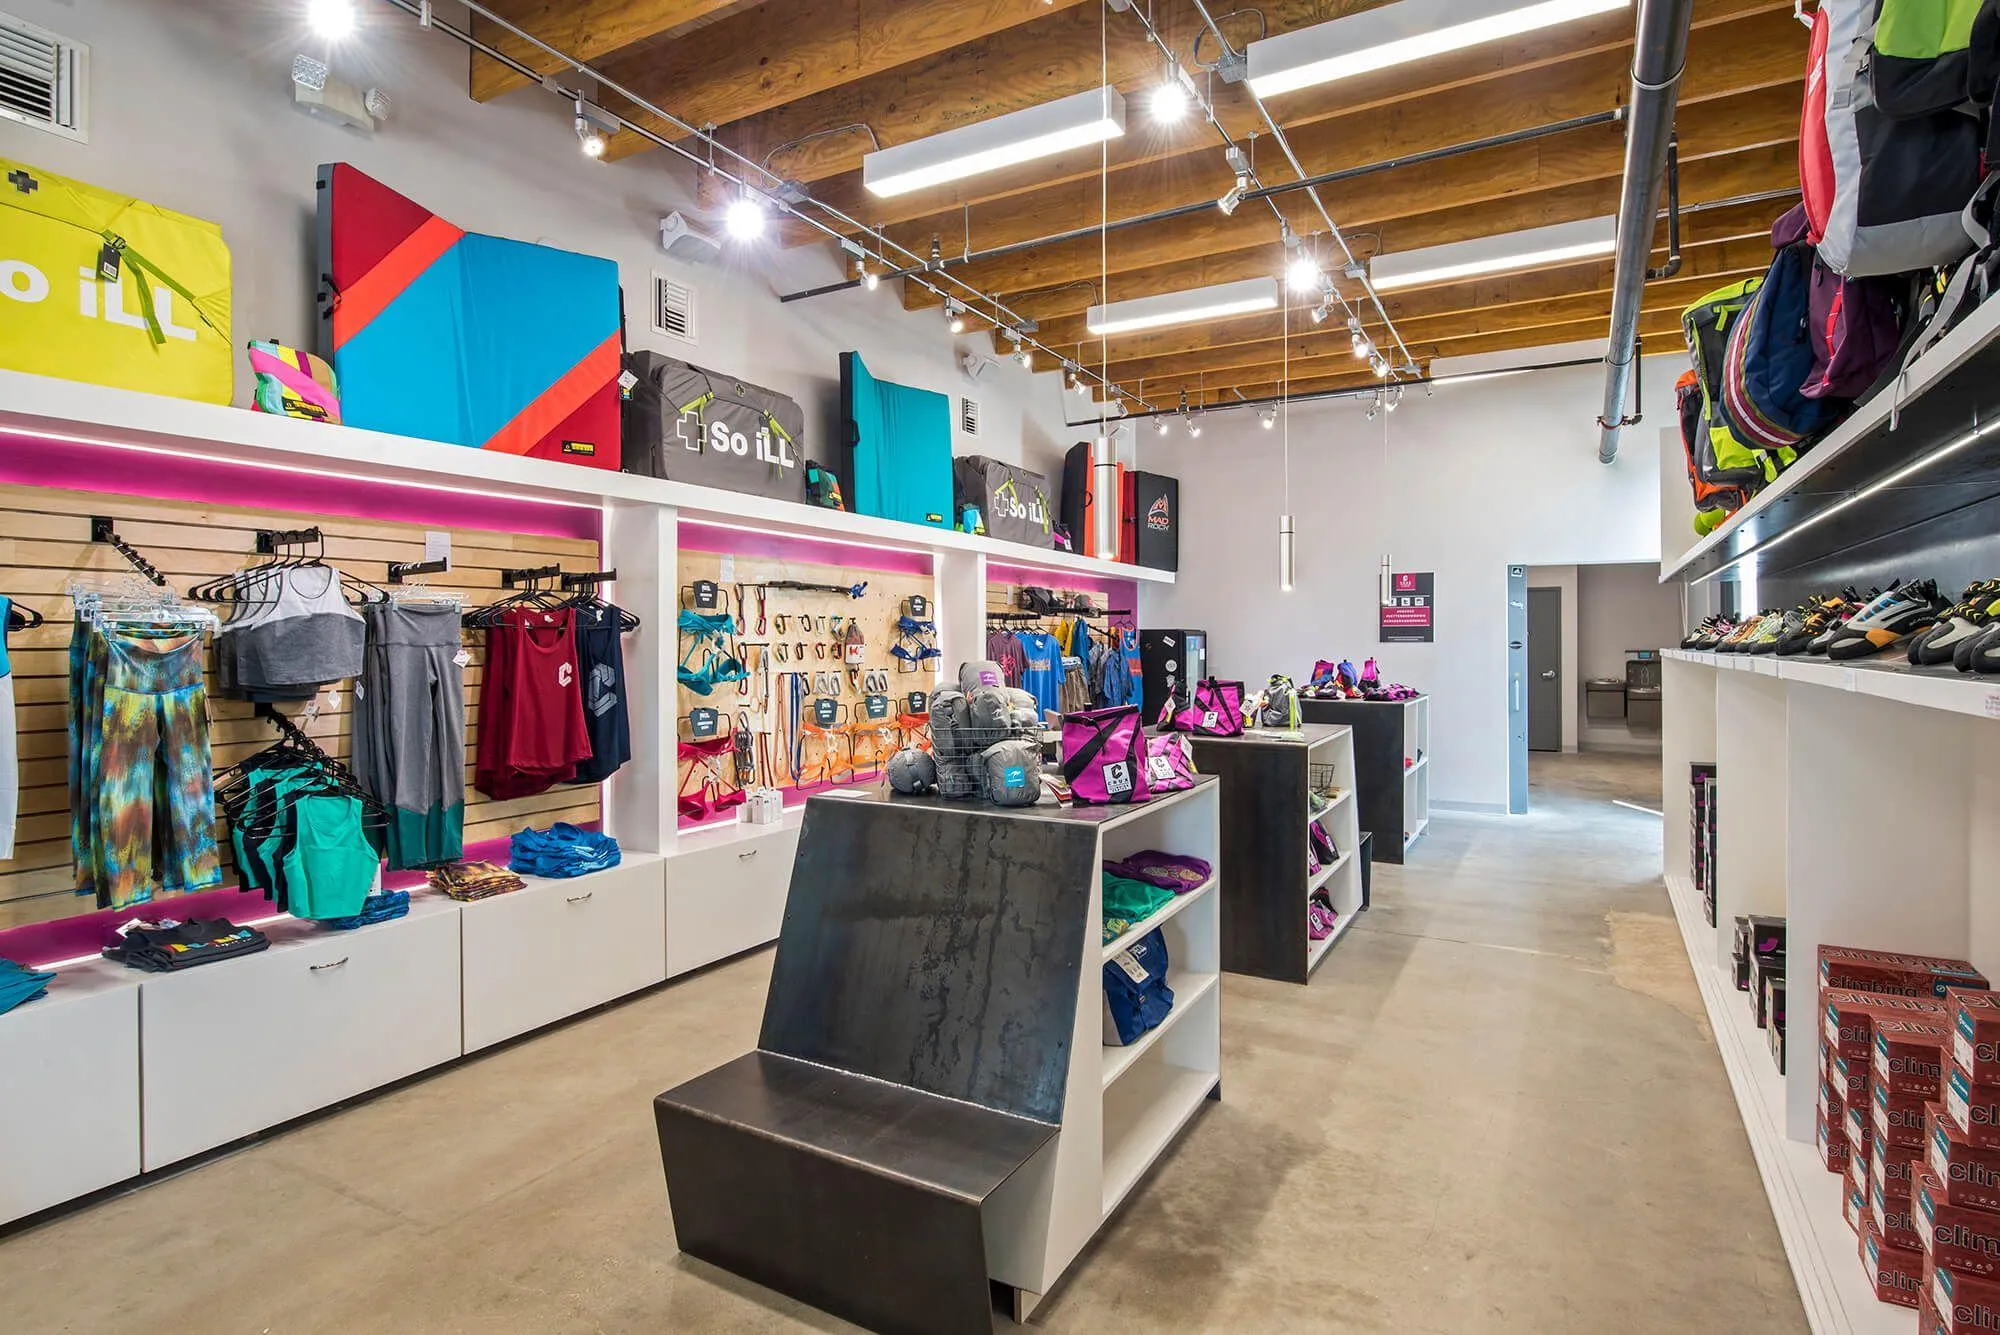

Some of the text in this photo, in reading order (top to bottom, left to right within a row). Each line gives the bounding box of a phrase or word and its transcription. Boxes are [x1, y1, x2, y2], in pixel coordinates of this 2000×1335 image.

[79, 266, 196, 341] iLL
[711, 421, 795, 468] So iLL
[1010, 497, 1026, 519] So
[1148, 516, 1169, 525] MAD
